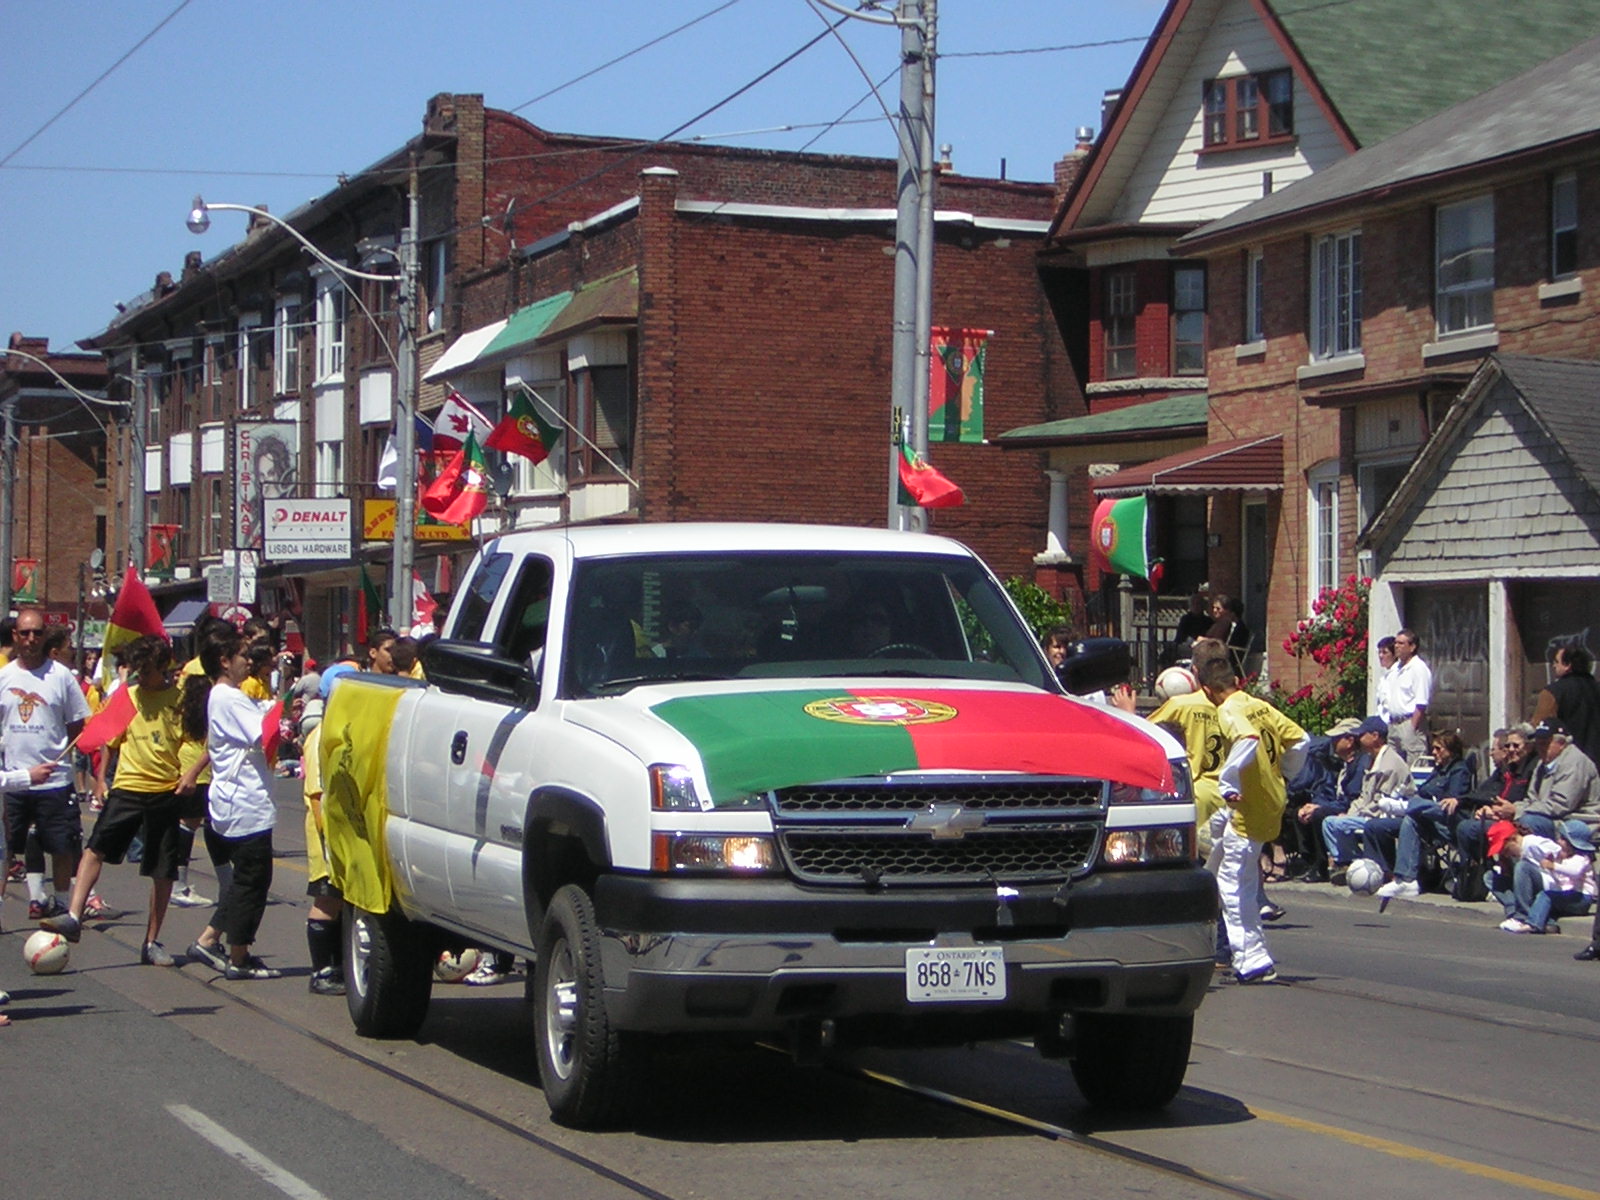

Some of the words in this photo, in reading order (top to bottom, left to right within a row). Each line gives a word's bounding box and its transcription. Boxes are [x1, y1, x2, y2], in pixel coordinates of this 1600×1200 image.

[240, 430, 251, 535] CHRISTINAS
[291, 511, 347, 523] DENALT
[302, 544, 348, 554] HARDWARE
[1201, 734, 1223, 772] 3
[1260, 729, 1276, 765] 9
[936, 951, 976, 961] ONTARIO
[917, 962, 951, 987] 858
[963, 961, 996, 987] 7NS
